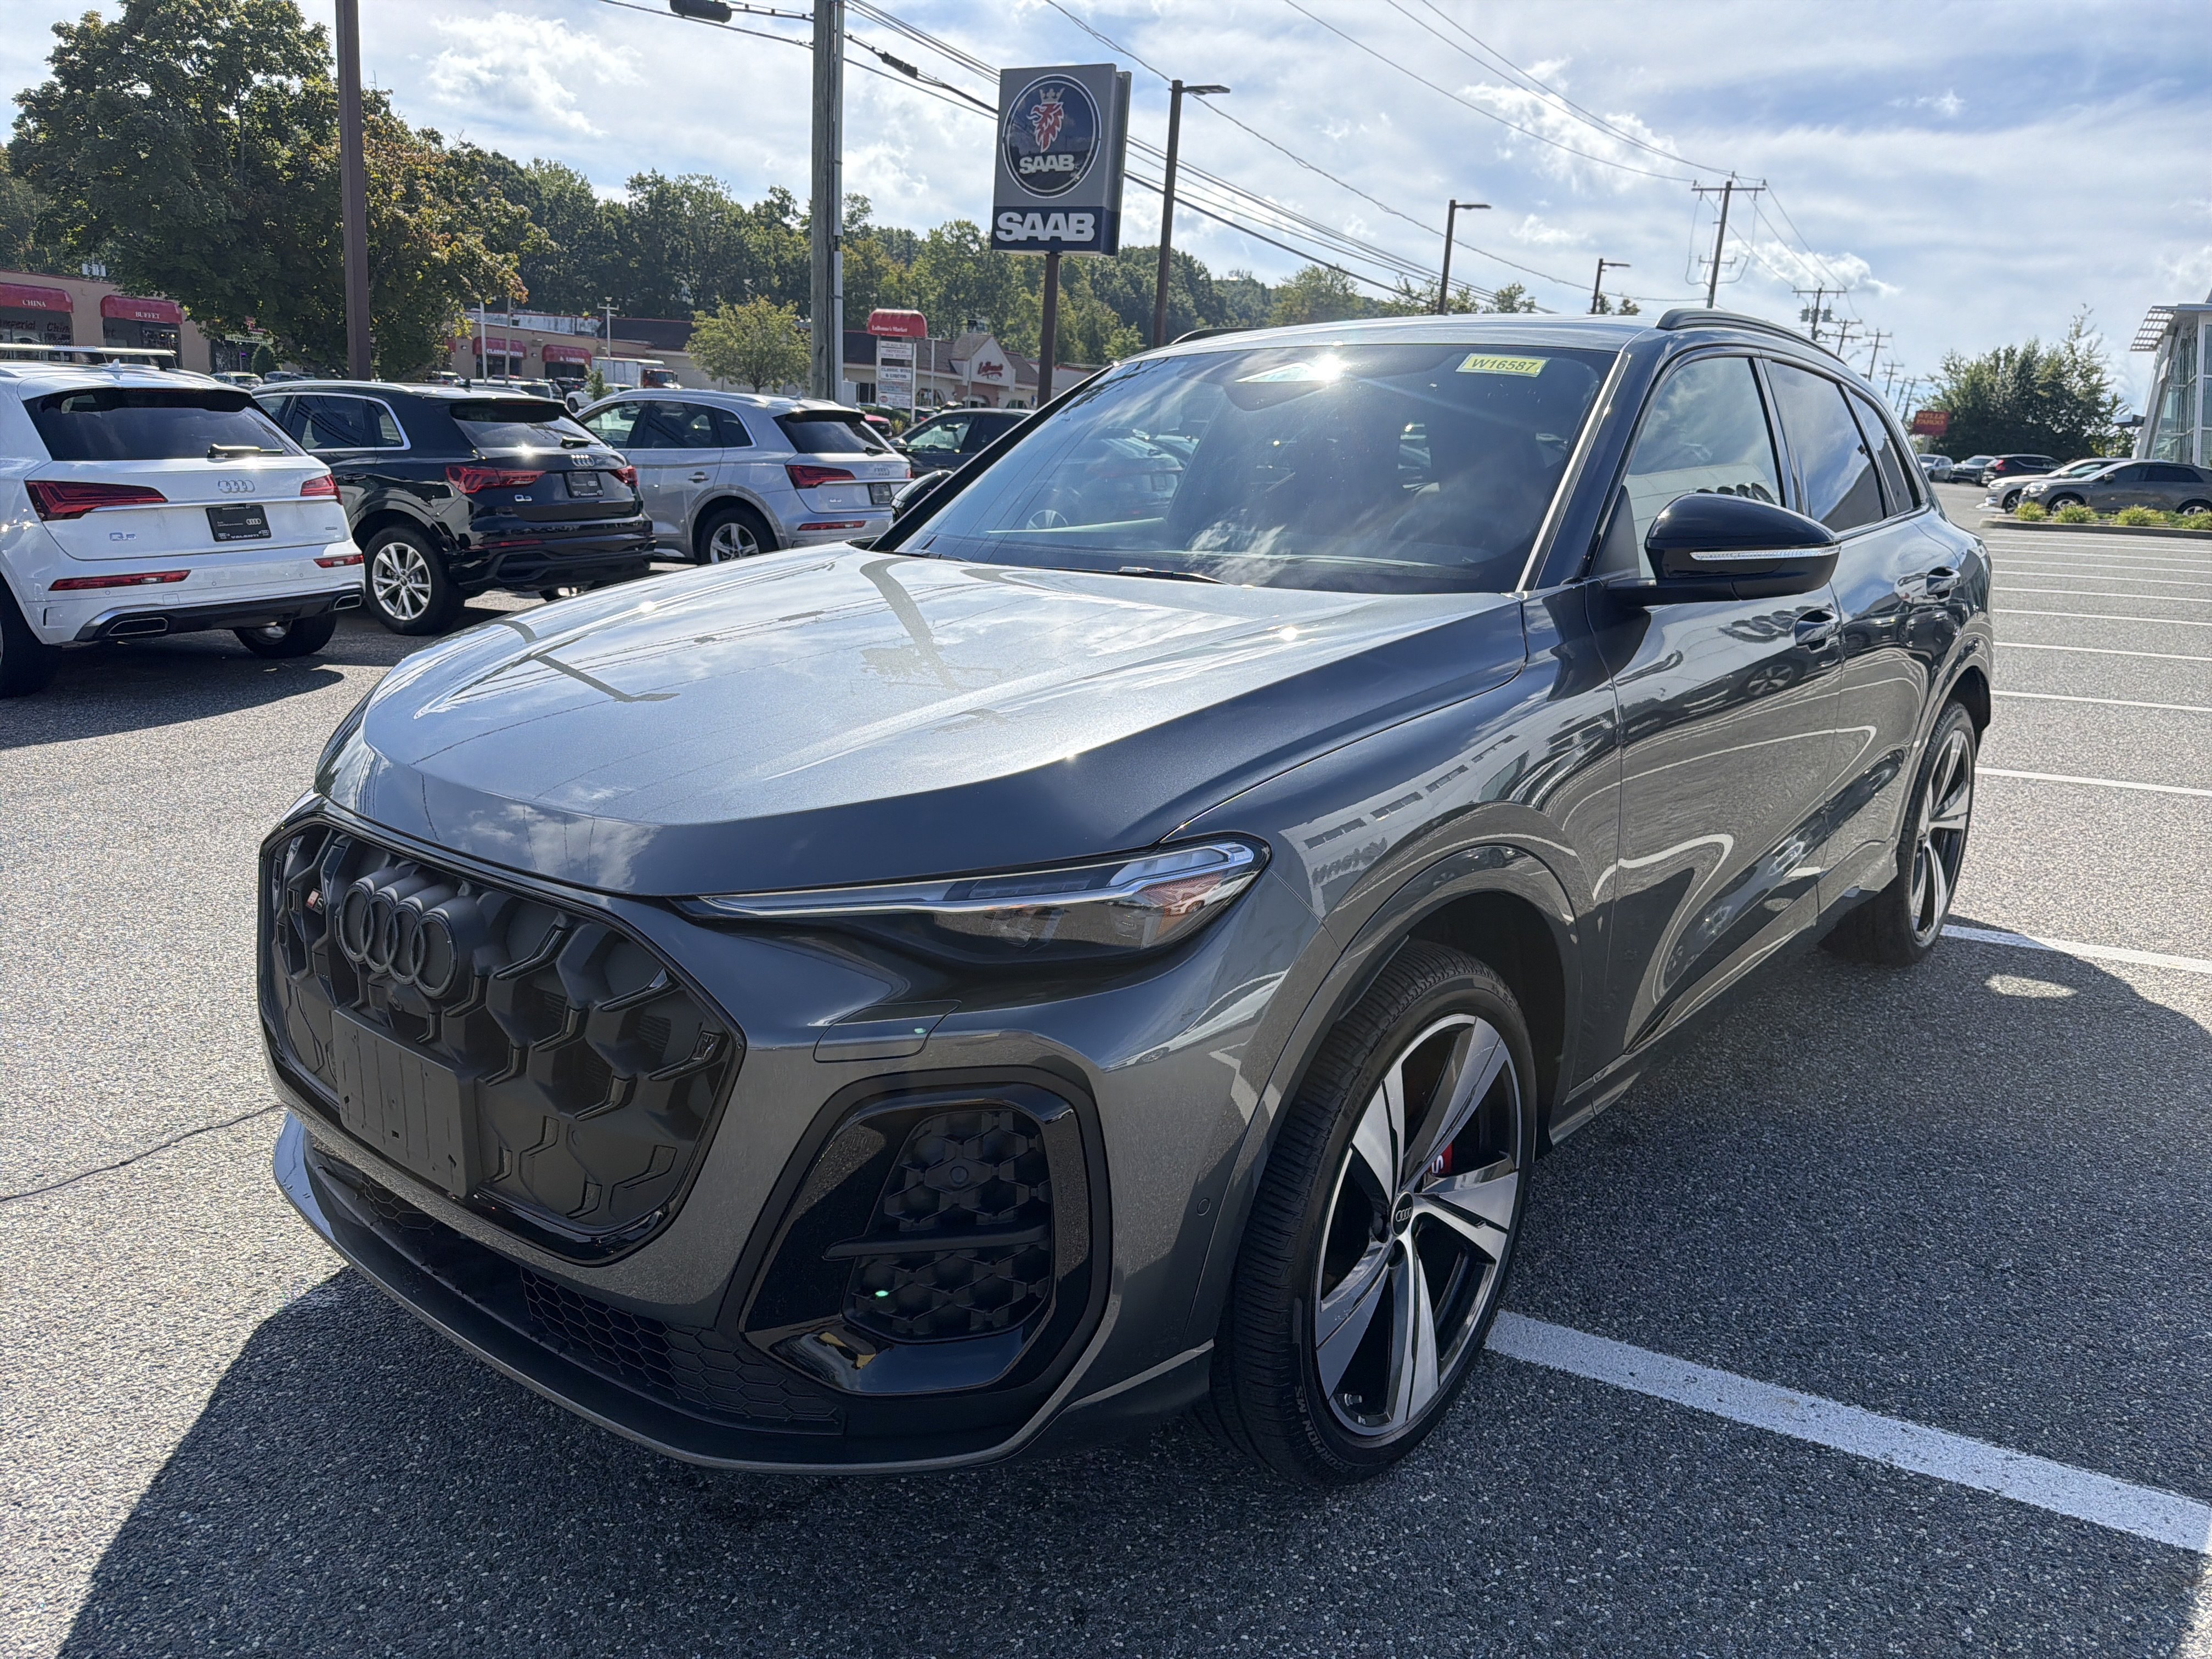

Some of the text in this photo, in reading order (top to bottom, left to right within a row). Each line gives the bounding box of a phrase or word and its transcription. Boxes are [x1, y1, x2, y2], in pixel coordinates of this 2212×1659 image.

[1019, 154, 1075, 174] SAAB
[996, 212, 1095, 242] SAAB
[22, 299, 46, 307] CHINA
[135, 311, 160, 319] BUFFET
[1471, 358, 1537, 372] W16587
[109, 532, 137, 541] Q5
